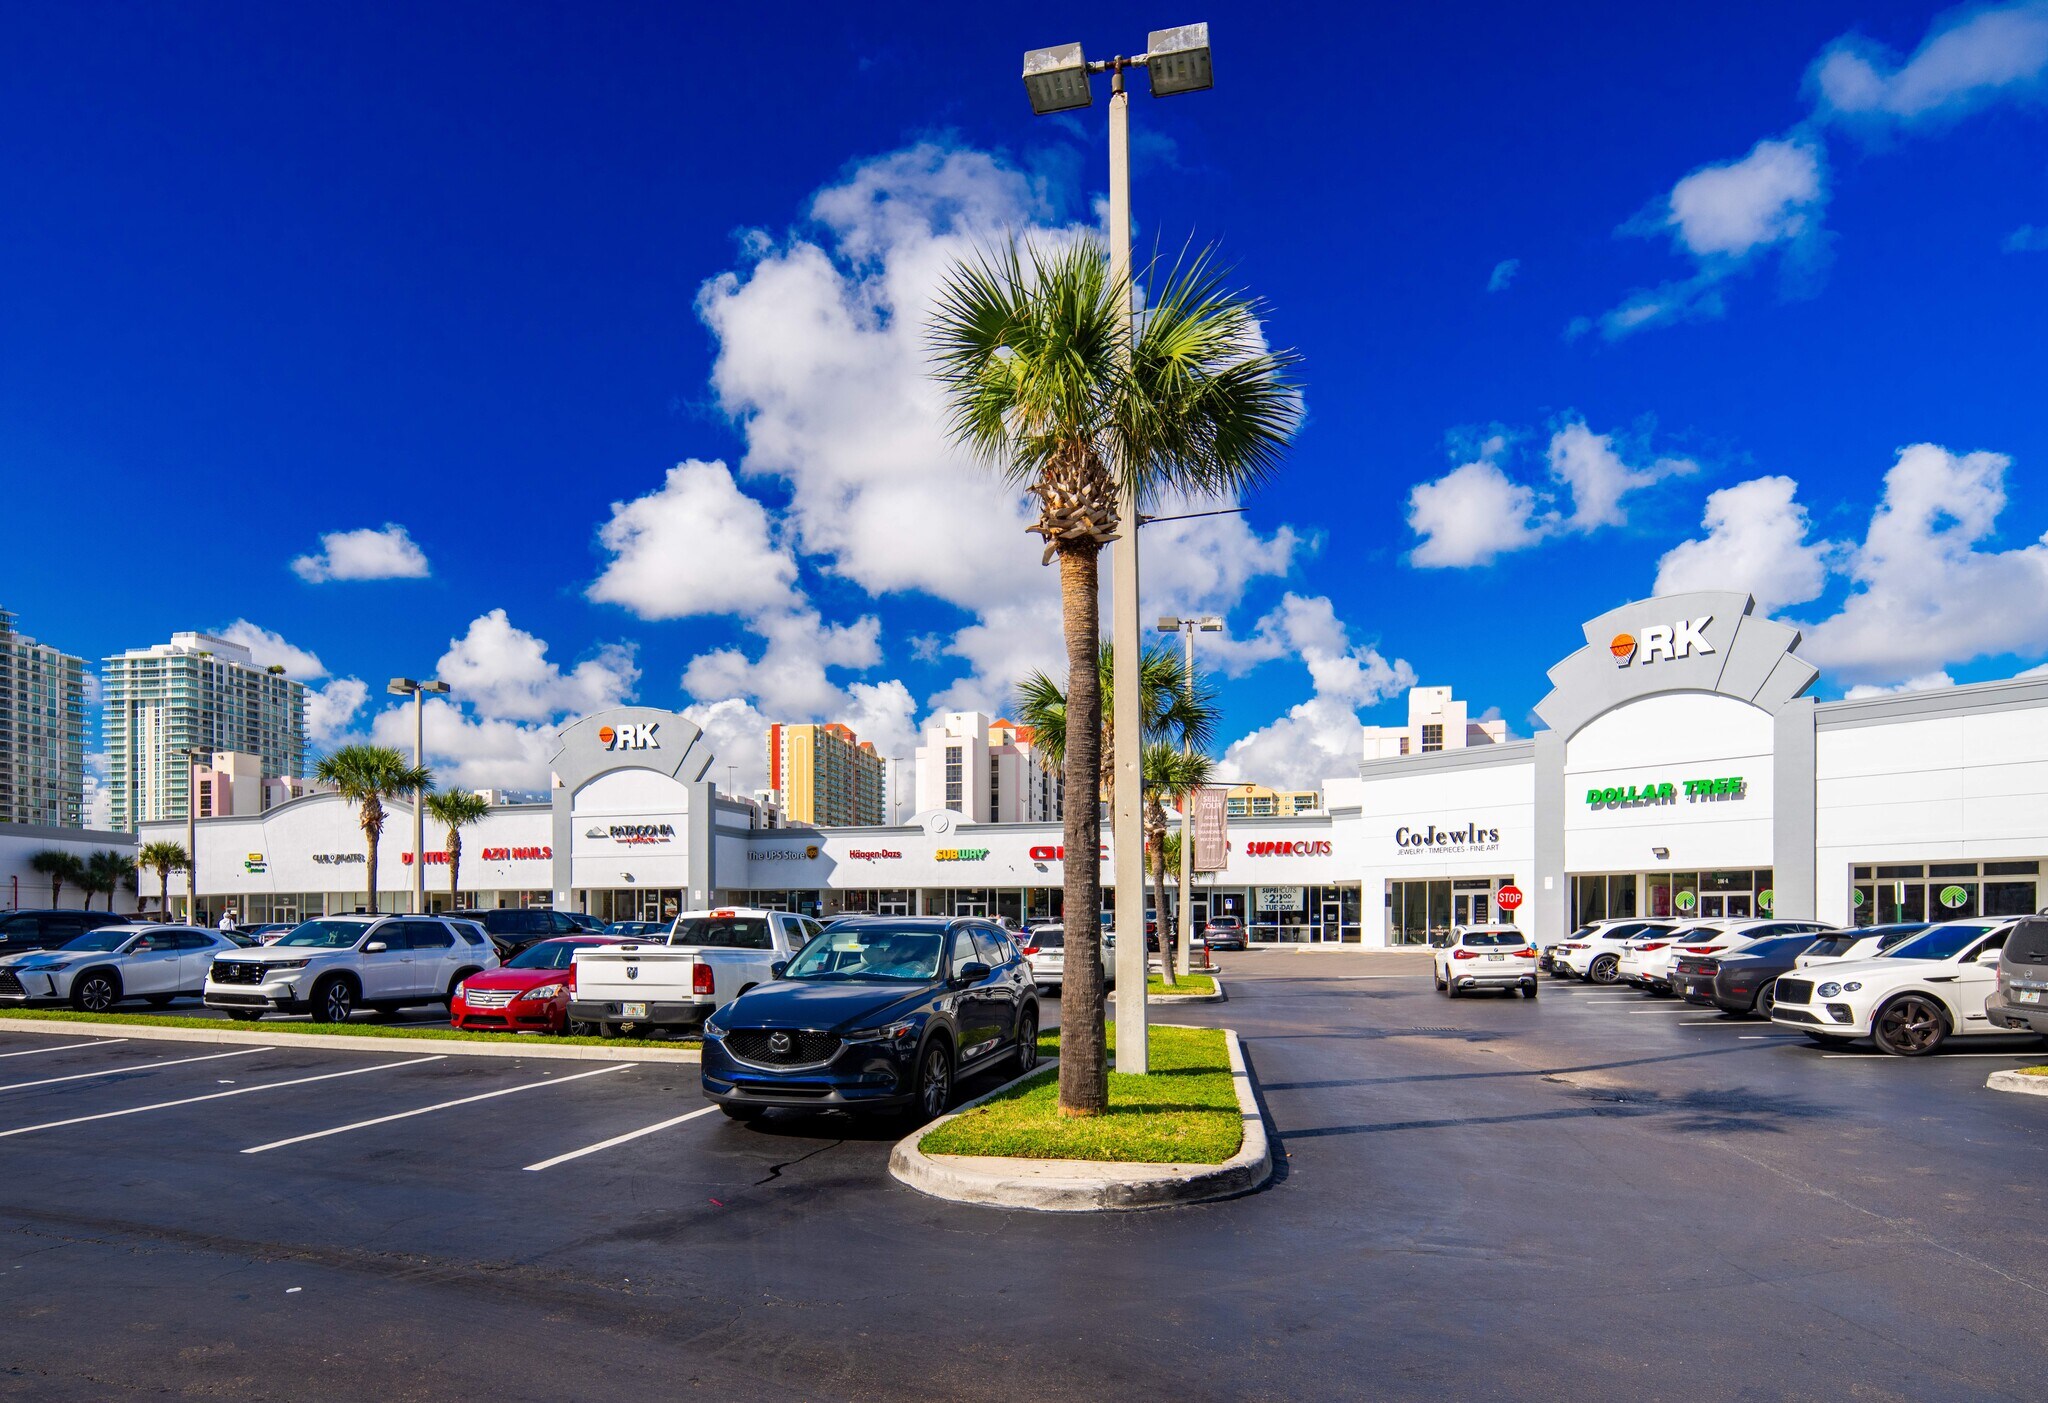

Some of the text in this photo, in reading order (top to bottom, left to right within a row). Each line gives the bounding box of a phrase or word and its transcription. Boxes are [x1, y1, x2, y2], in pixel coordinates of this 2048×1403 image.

[1641, 615, 1715, 664] RK
[617, 722, 659, 749] RK
[1586, 776, 1743, 804] DOLLAR TREE
[610, 824, 675, 837] PATAGONIA
[1396, 822, 1499, 848] CoJewlrs
[512, 846, 552, 860] NAILS
[748, 851, 763, 860] The
[766, 850, 782, 860] UPS
[784, 851, 806, 860] Store
[934, 848, 988, 860] SUBWAY
[1246, 841, 1332, 855] SUPERCUTS
[1397, 848, 1424, 856] JEWELRY
[1429, 846, 1465, 854] TIMEPIECES
[1498, 892, 1522, 903] STOP
